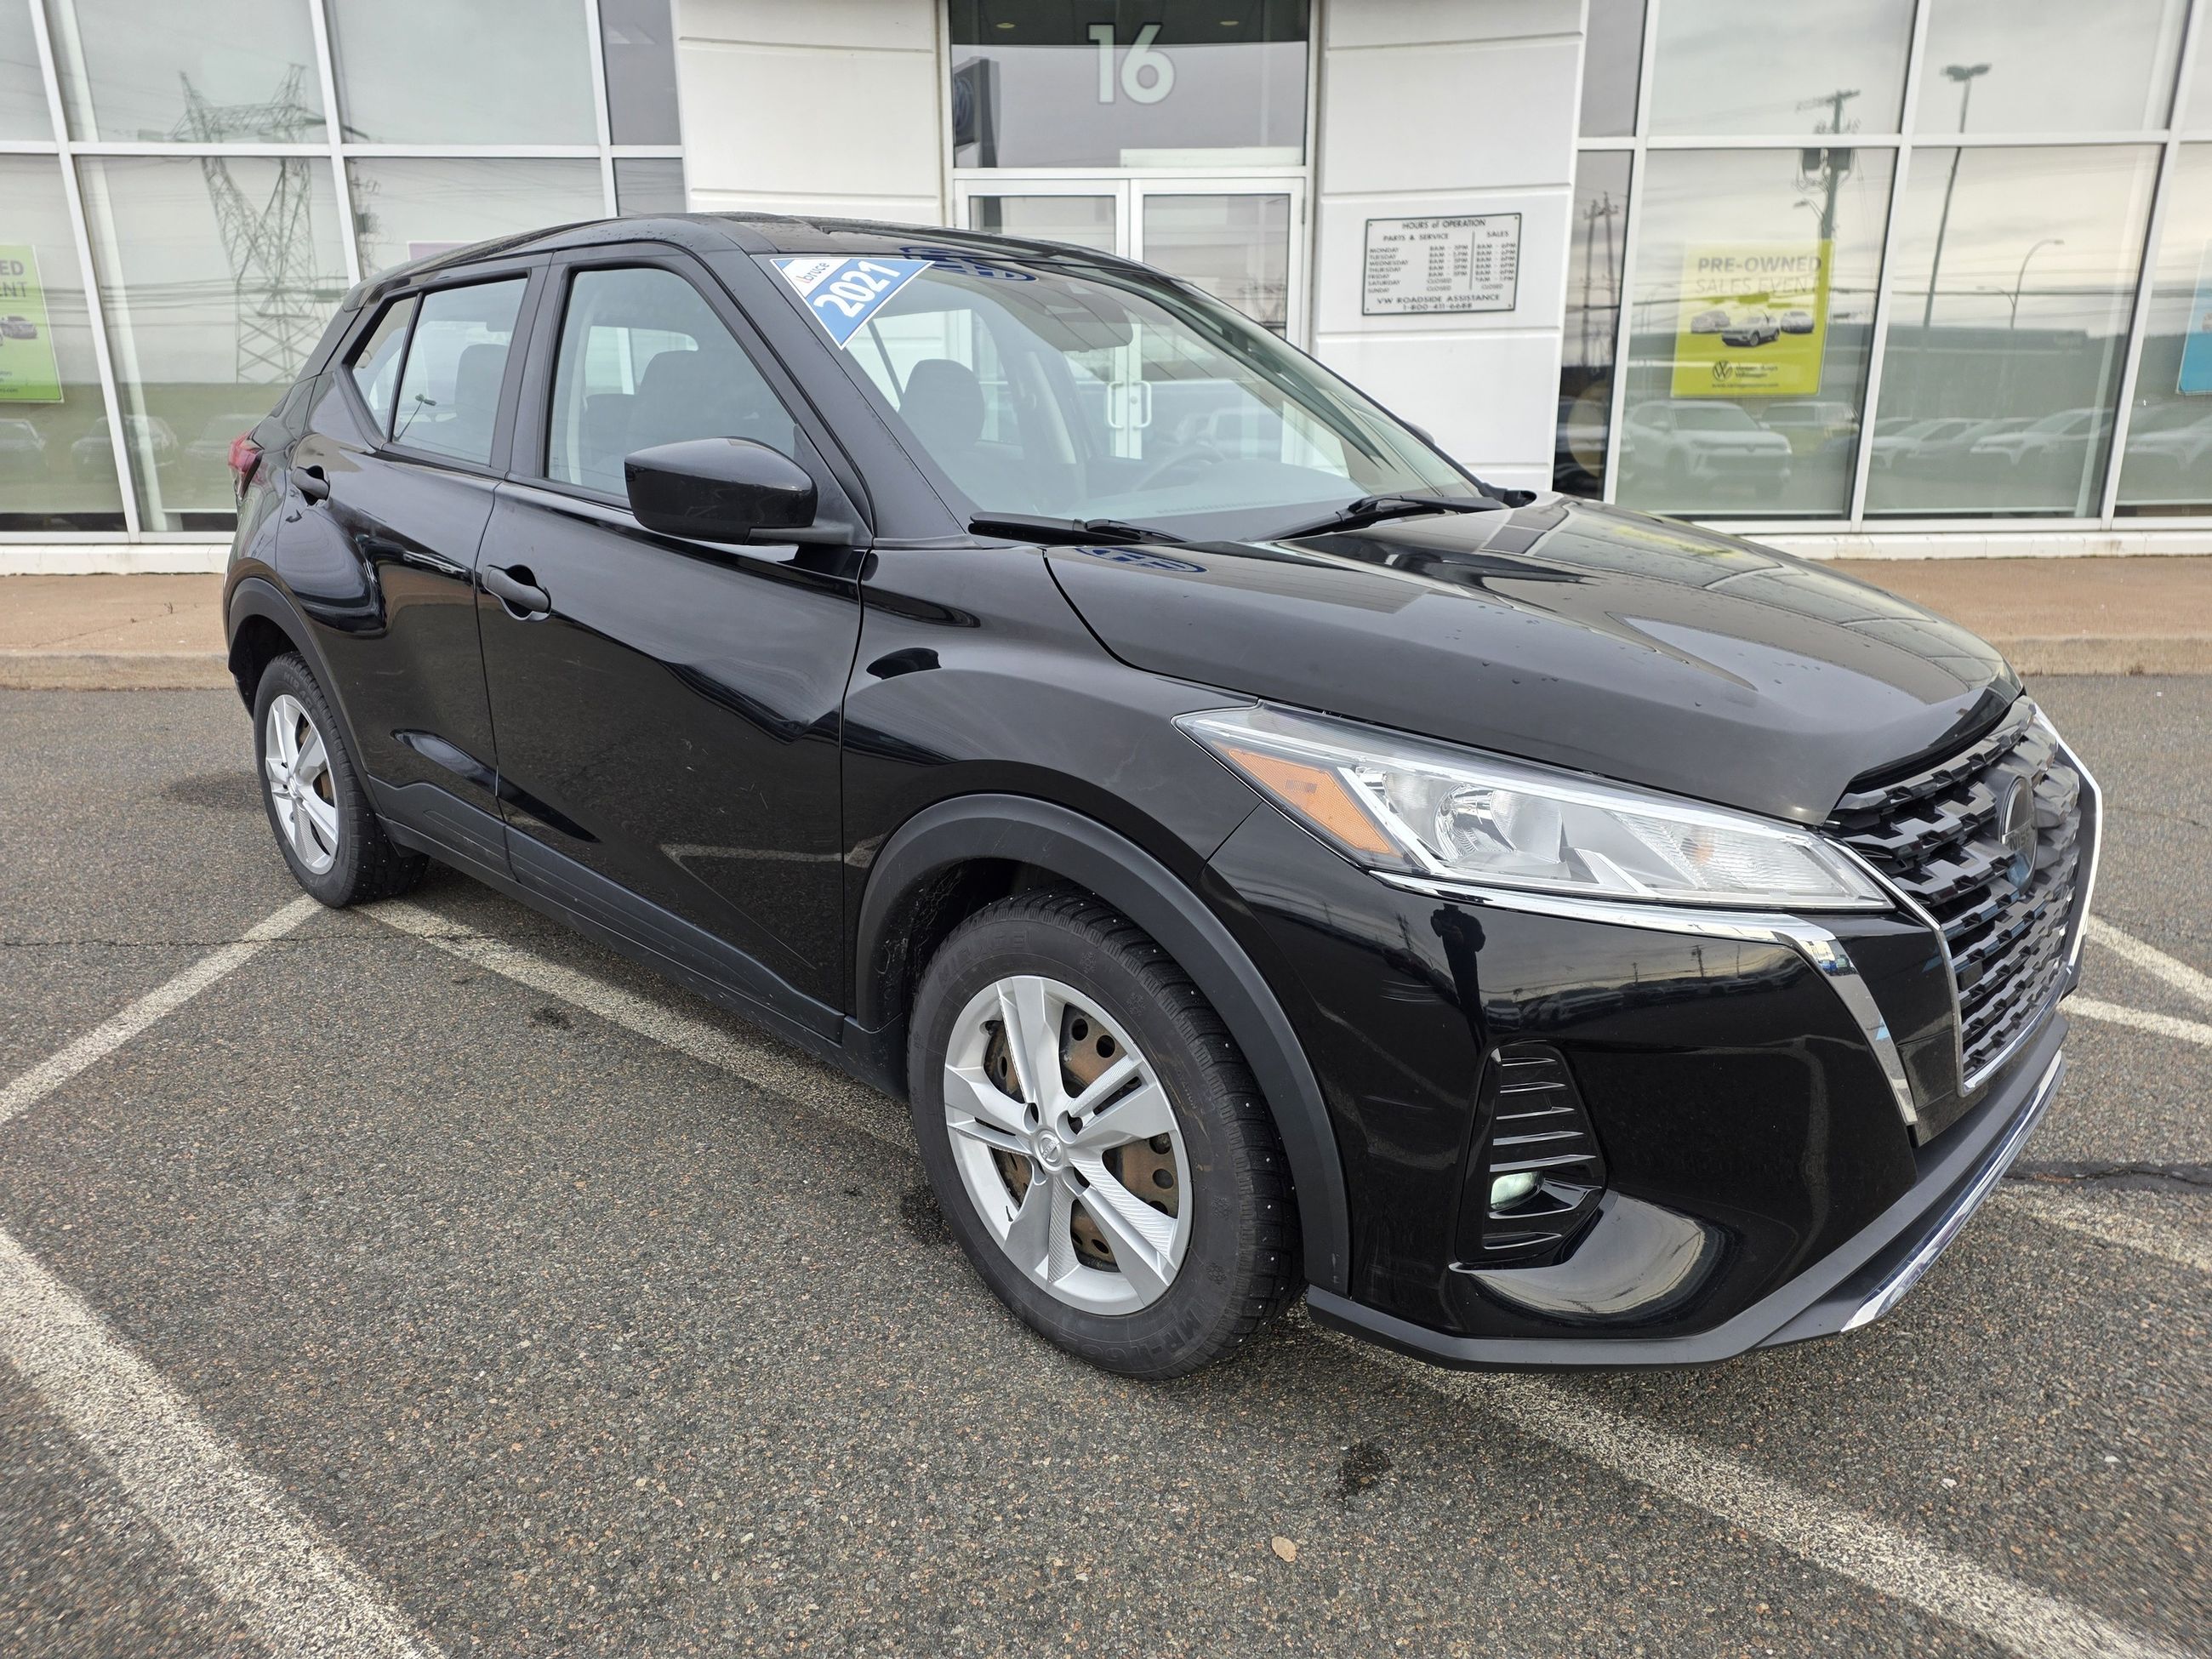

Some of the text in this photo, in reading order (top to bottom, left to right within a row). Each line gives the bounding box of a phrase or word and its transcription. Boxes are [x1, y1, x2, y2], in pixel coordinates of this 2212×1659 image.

[1087, 22, 1176, 105] 16
[1442, 219, 1486, 228] OPERATION
[1698, 257, 1821, 273] PRE-OWNED
[813, 261, 900, 318] 2021
[1696, 278, 1751, 294] SALES
